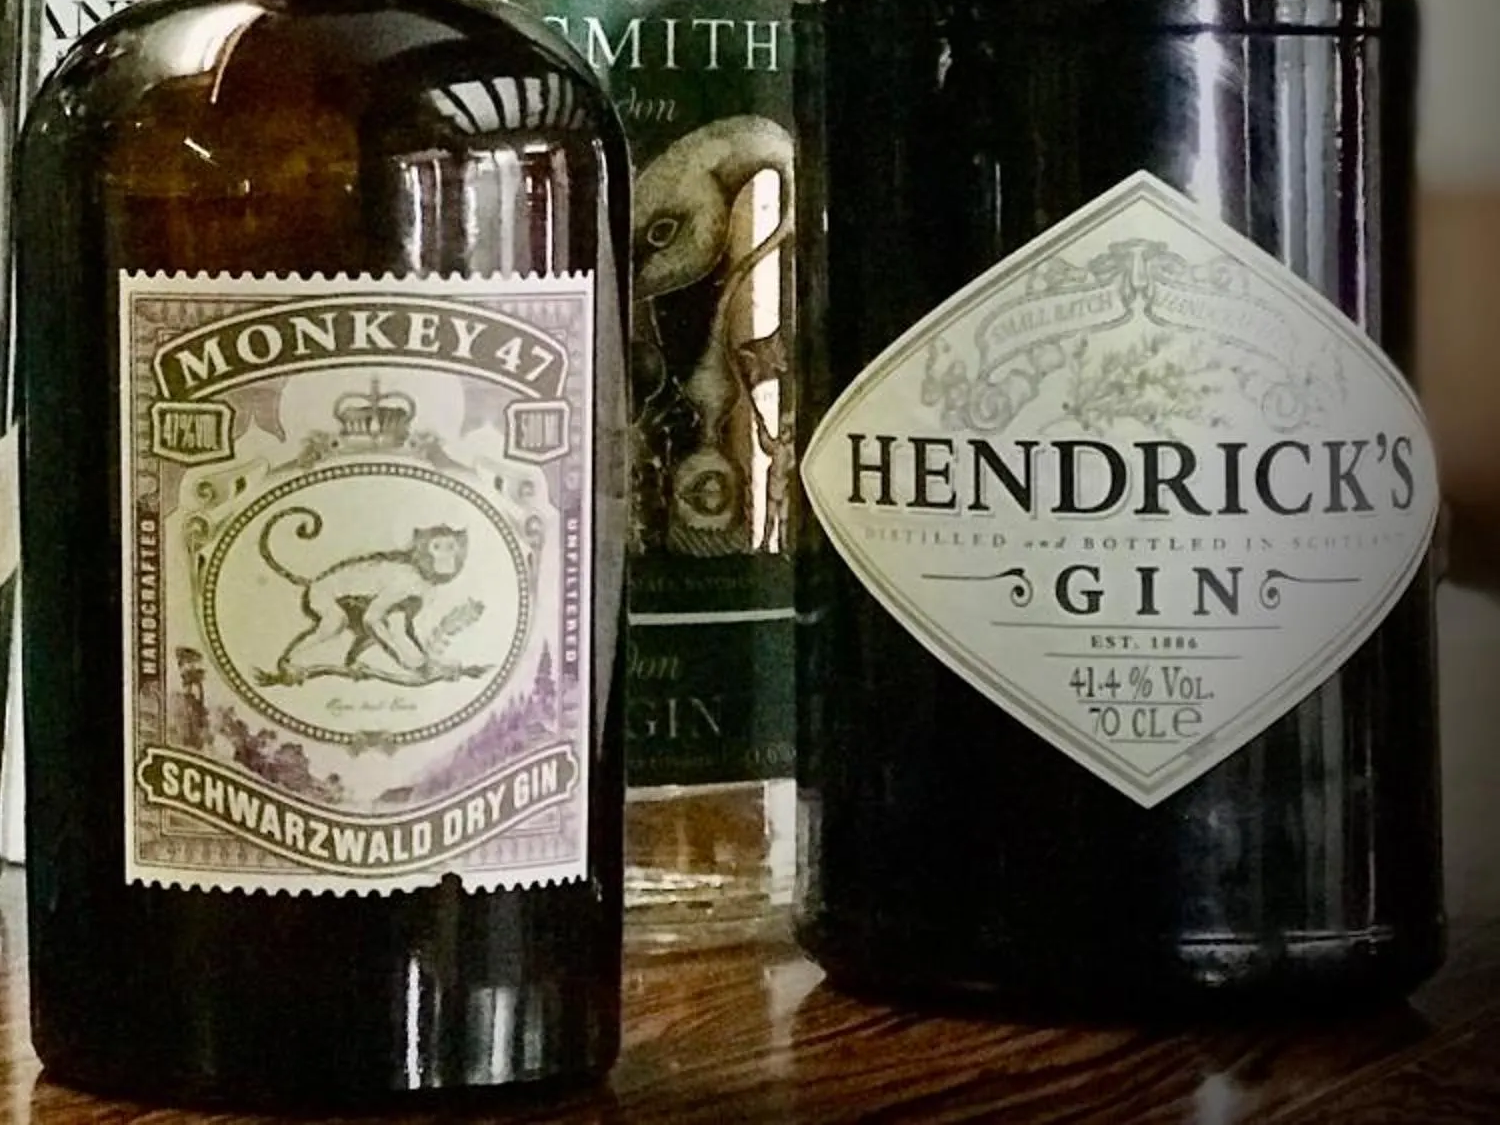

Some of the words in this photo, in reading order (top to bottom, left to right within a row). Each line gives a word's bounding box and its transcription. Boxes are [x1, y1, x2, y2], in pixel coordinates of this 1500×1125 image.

[173, 312, 488, 390] MONKEY
[493, 337, 556, 385] 47
[845, 431, 1415, 518] HENDRICK'S
[864, 527, 1007, 550] DISTILLED
[1023, 534, 1067, 551] and
[1083, 536, 1228, 552] BOTTLED
[1244, 536, 1275, 552] IN
[139, 518, 156, 676] HANDCRAFTED
[564, 517, 581, 665] UNFILTERED
[1054, 564, 1244, 617] GIN
[1090, 634, 1140, 650] EST.
[1150, 634, 1199, 650] 1886
[627, 695, 723, 741] GIN
[1087, 706, 1121, 738] 70
[160, 758, 432, 865] SCHWARZWALD
[442, 785, 503, 847] DRY
[512, 759, 559, 807] GIN
